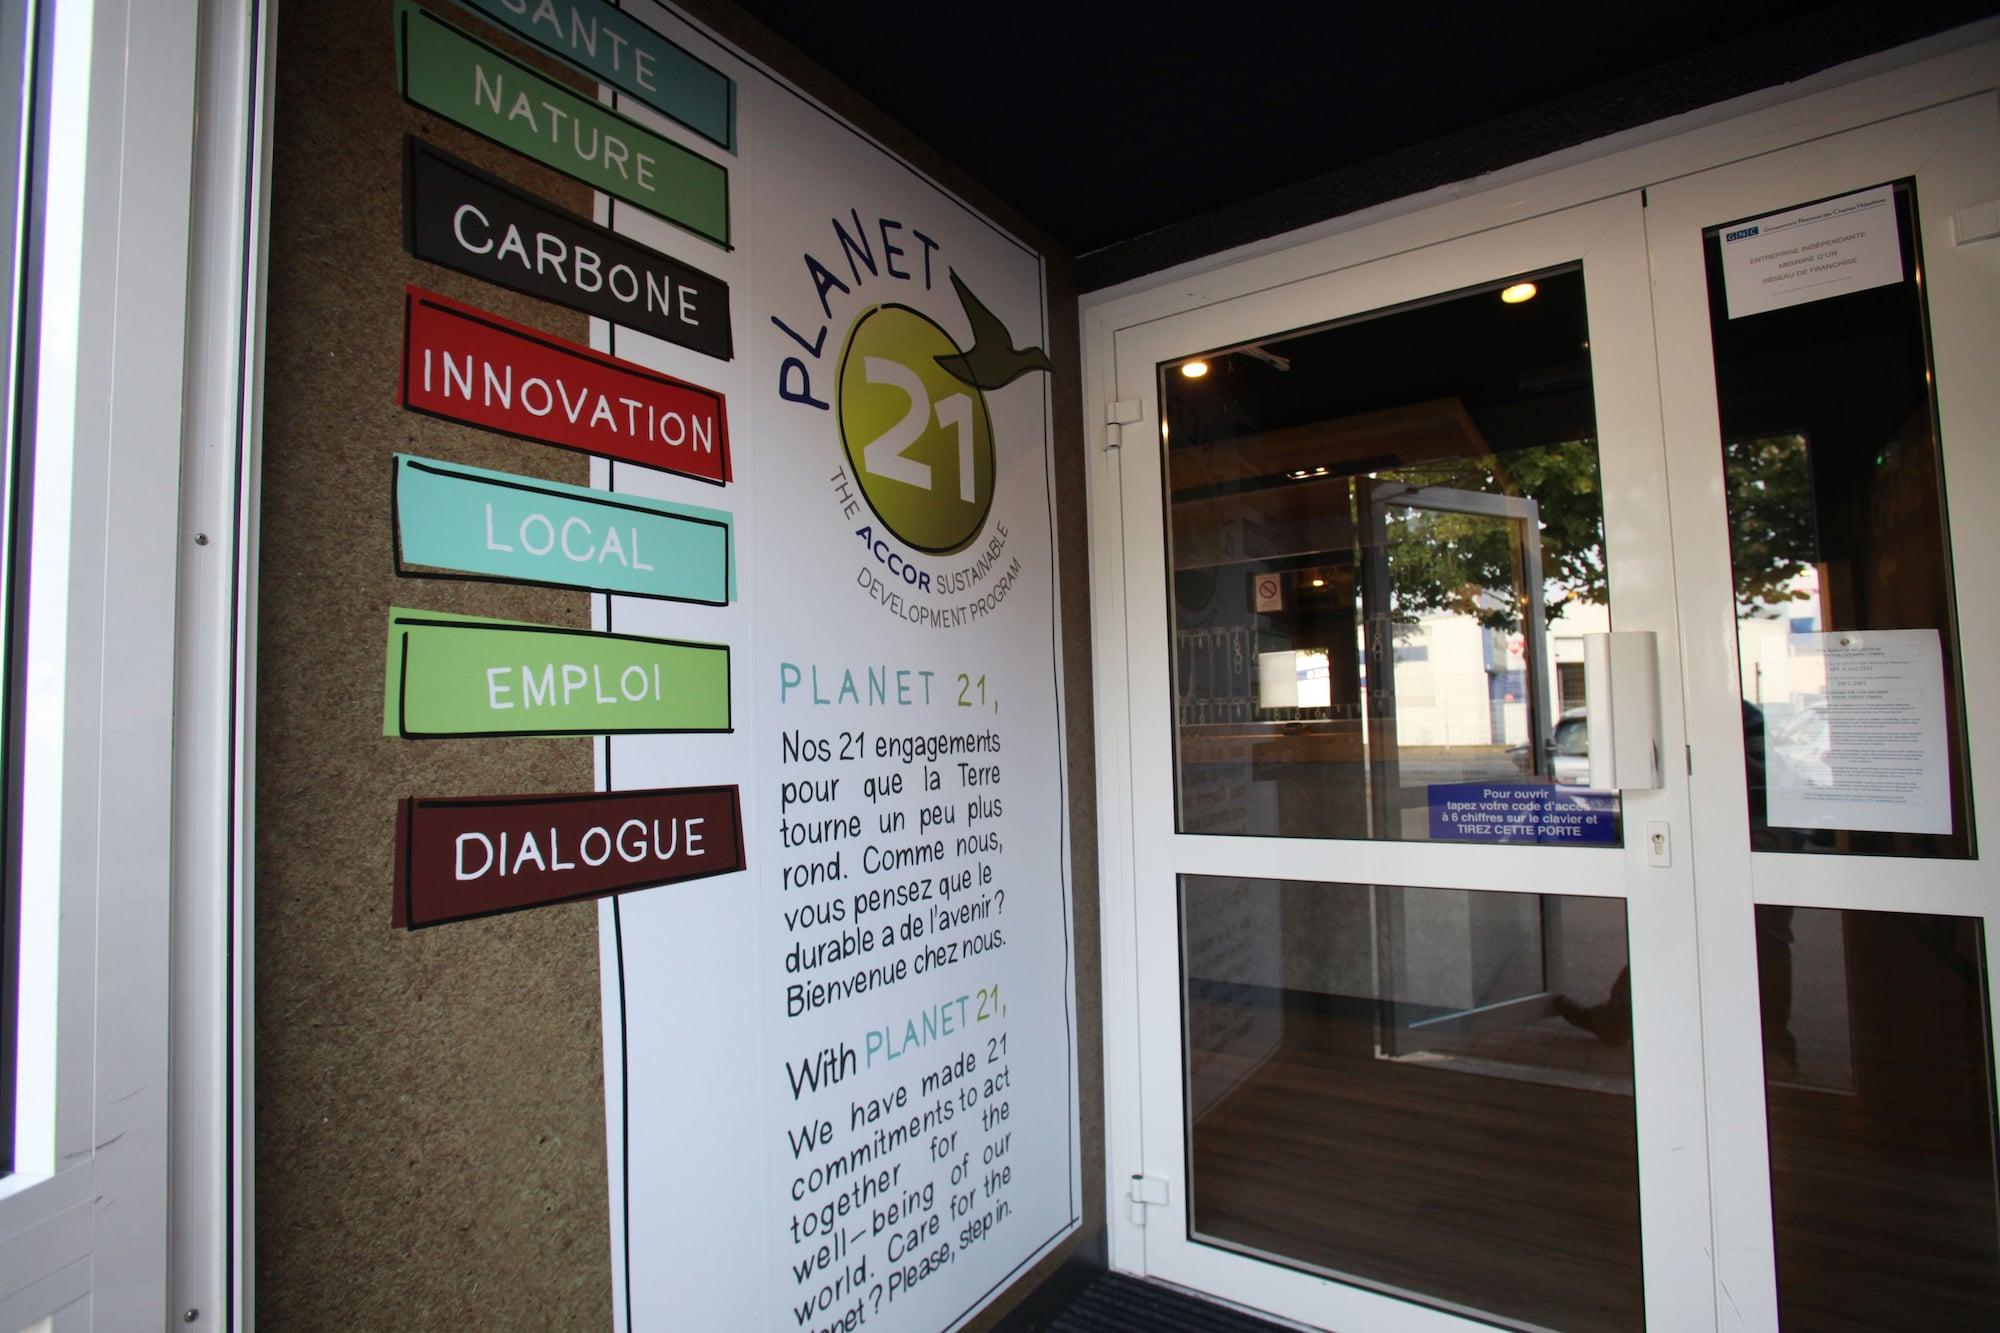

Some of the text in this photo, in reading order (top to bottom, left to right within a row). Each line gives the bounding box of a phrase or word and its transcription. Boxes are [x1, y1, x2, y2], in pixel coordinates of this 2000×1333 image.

[501, 0, 657, 92] ANTE
[475, 64, 656, 192] NATURE
[453, 204, 700, 327] CARBONE
[1726, 226, 1759, 242] GNC
[1750, 247, 1799, 264] ENTREPRISE
[1778, 250, 1838, 269] MEMBRE D'UN
[1797, 268, 1808, 277] DE
[1810, 257, 1858, 273] FRANCHISE
[771, 208, 940, 411] PLANET
[424, 349, 712, 454] INNOVATION
[863, 356, 975, 504] 21
[486, 503, 654, 571] LOCAL
[830, 466, 1009, 595] THE ACCOR SUSTAINABLE
[857, 557, 1022, 628] DEVELOPMENT PROGRAM
[487, 663, 660, 710] EMPLOI
[781, 662, 999, 714] PLANET 21,
[782, 729, 1001, 764] Nos 21 engagements
[780, 795, 1003, 847] tourne un peu plus
[781, 763, 1000, 813] pour que la Terre
[1442, 812, 1597, 824] à 6 chiffres sur le clavier et
[1447, 802, 1476, 811] tapez
[1479, 802, 1508, 811] votre
[1512, 802, 1541, 811] code
[1484, 789, 1549, 799] Pour ouvrir
[455, 817, 705, 881] DIALOGUE
[784, 832, 1003, 890] rond. Comme nous,
[1457, 824, 1582, 836] TIREZ CETTE PORTE
[785, 862, 992, 931] vous pensez que le
[785, 927, 875, 973] durable
[882, 926, 894, 946] a
[901, 914, 923, 940] de
[787, 929, 1006, 1018] Bienvenue chez nous.
[786, 984, 1007, 1101] With PLANET 21,
[788, 1032, 1007, 1159] We have made 21
[792, 1066, 1010, 1201] commitments to act
[951, 1153, 969, 1186] of
[983, 1132, 1011, 1165] our
[790, 1102, 1010, 1245] together for the
[794, 1166, 1012, 1326] world. Care for the
[889, 1242, 954, 1302] Please,
[959, 1215, 992, 1250] step
[996, 1199, 1012, 1224] in.
